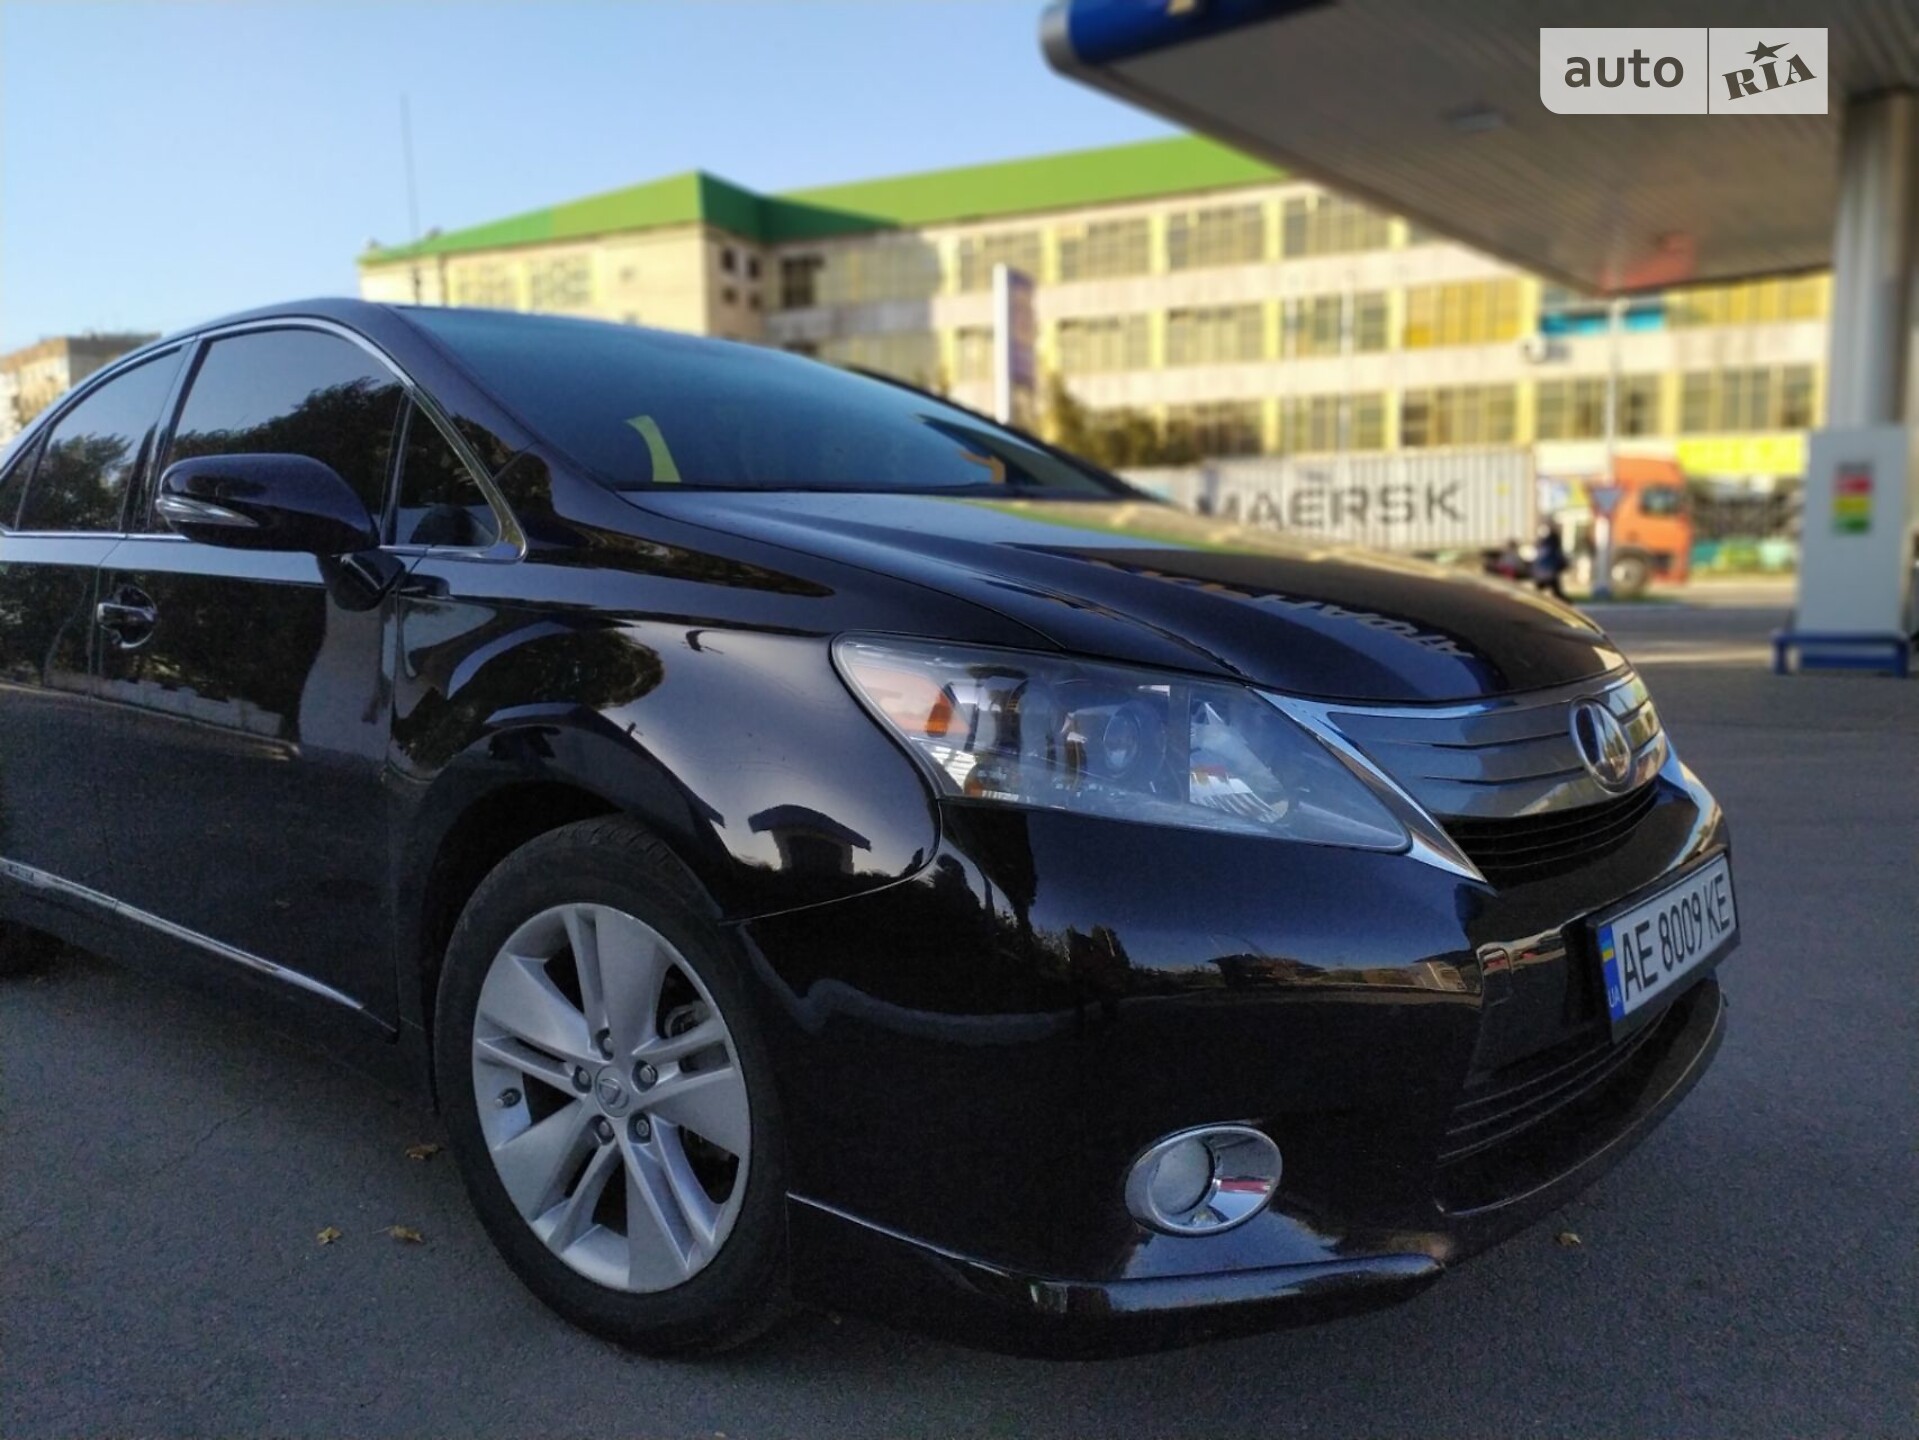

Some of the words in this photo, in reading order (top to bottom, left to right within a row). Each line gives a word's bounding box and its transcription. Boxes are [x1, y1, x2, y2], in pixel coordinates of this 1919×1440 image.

[1622, 920, 1658, 1001] AE
[1658, 892, 1703, 972] 8009
[1704, 873, 1730, 940] KE
